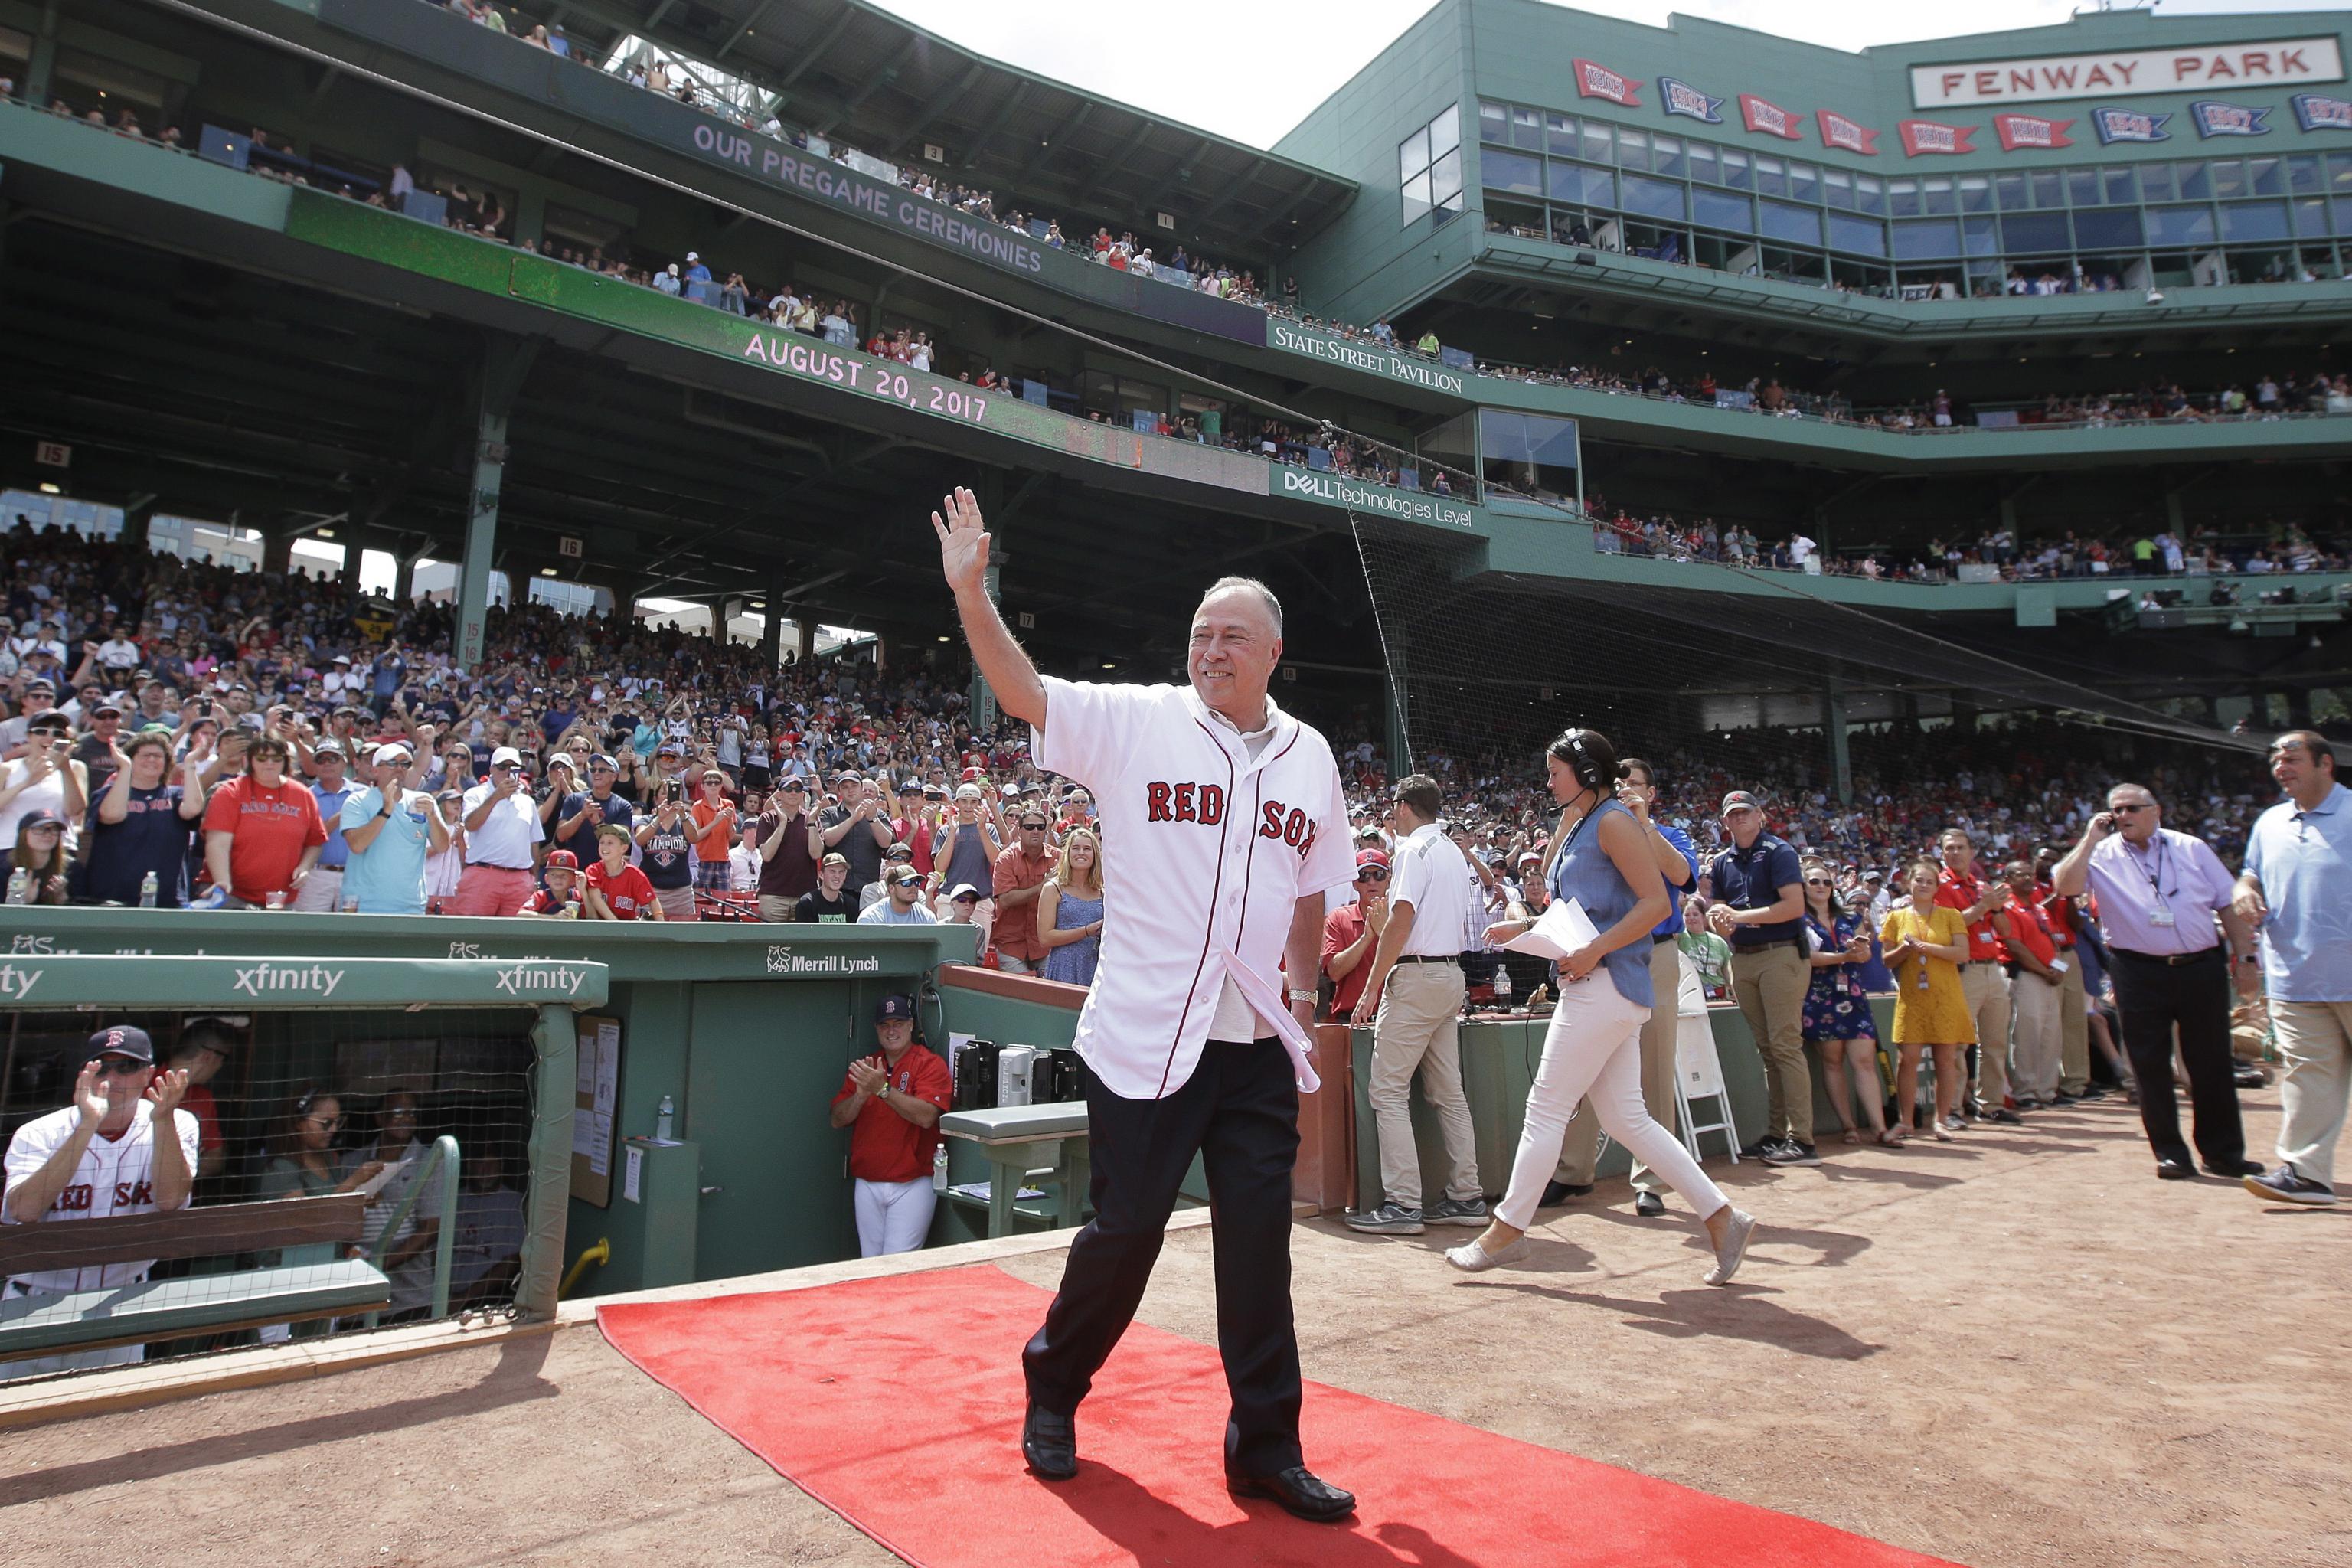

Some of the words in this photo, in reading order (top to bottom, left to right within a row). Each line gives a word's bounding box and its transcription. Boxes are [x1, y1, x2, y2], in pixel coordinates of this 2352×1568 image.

[1942, 60, 2138, 97] FENWAY
[2174, 48, 2310, 81] PARK
[1586, 70, 1625, 95] 1903
[1670, 87, 1707, 116] 1904
[1915, 127, 1955, 145] 1916
[2011, 122, 2051, 139] 1918
[931, 148, 938, 159] 3
[694, 125, 752, 166] OUR
[763, 149, 890, 217] PREGAME
[898, 202, 1042, 273] CEREMONIES
[1276, 327, 1325, 357] STATE
[1328, 341, 1386, 372] STREET
[1390, 357, 1462, 394] PAVILION
[744, 334, 864, 387] AUGUST
[876, 371, 916, 408] 20,
[929, 386, 986, 422] 2017
[45, 446, 63, 462] 15
[1284, 472, 1334, 500] DELL
[1334, 482, 1432, 520] Technologies
[1436, 503, 1472, 527] Level
[564, 540, 577, 554] 16
[467, 622, 478, 637] 15
[1023, 616, 1031, 626] 17
[465, 645, 476, 661] 16
[985, 697, 993, 707] 16
[984, 713, 991, 725] 17
[127, 799, 147, 814] ED
[1146, 781, 1225, 826] RED
[792, 956, 837, 972] Merrill
[841, 956, 879, 975] Lynch
[232, 962, 345, 997] xfinity
[496, 965, 586, 995] xfinity
